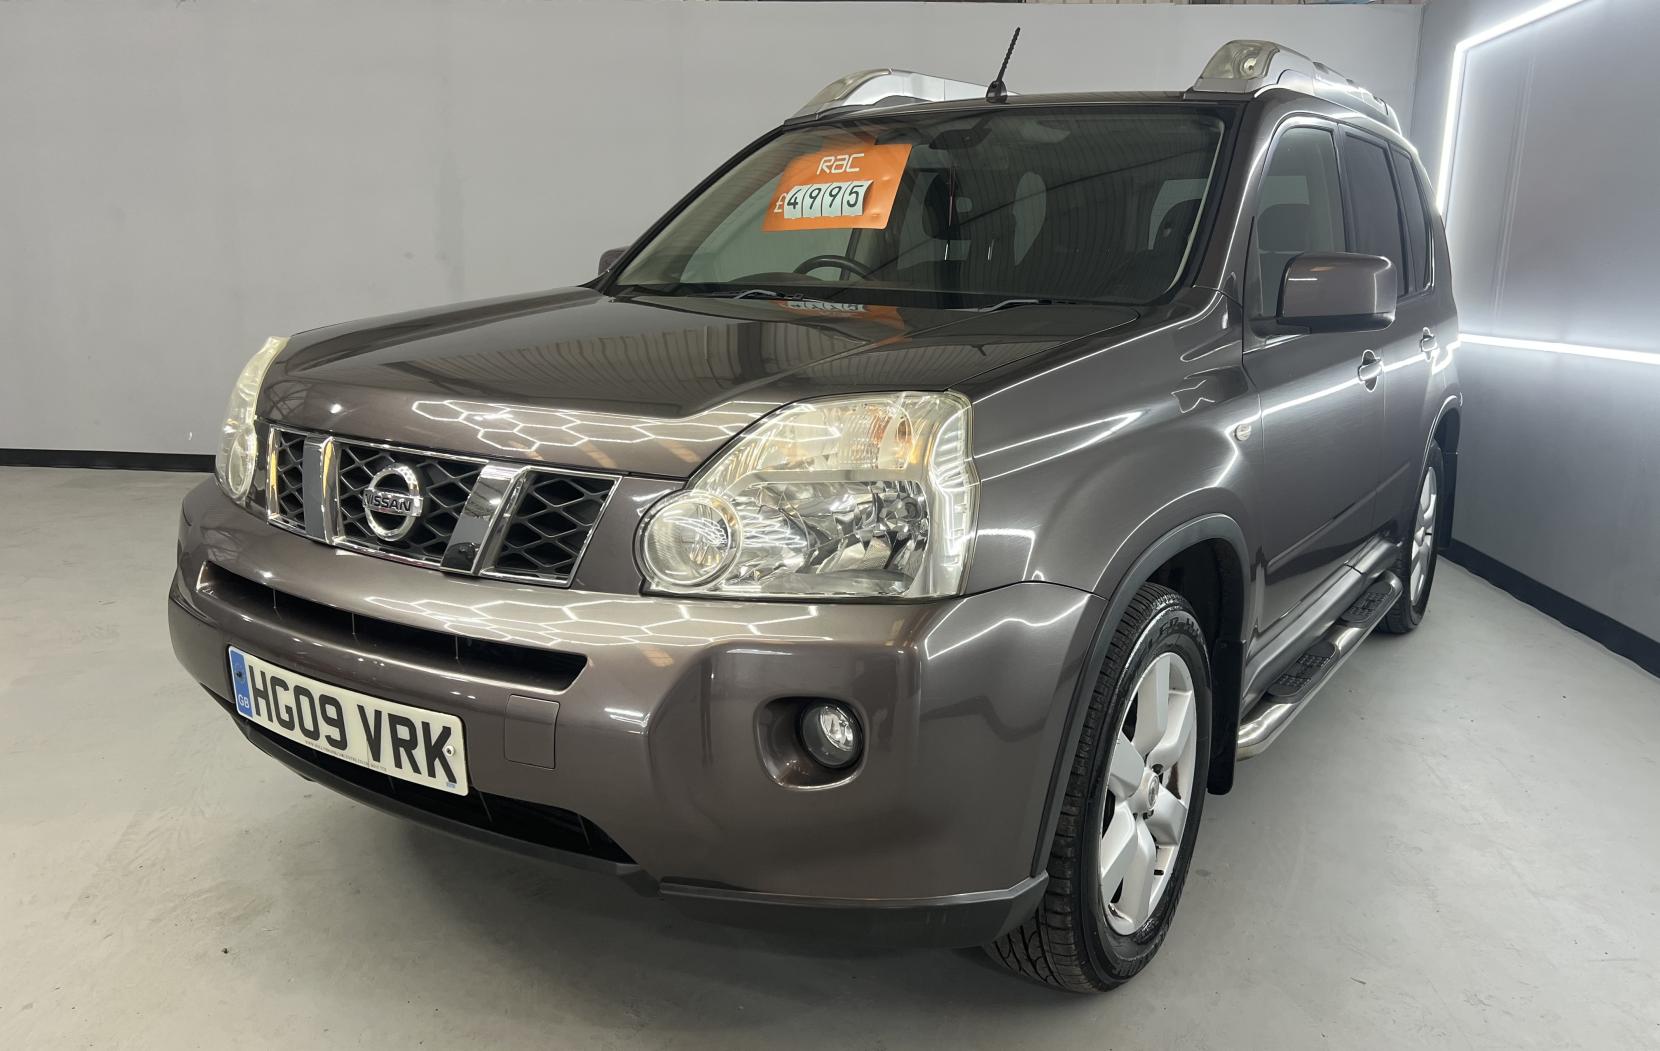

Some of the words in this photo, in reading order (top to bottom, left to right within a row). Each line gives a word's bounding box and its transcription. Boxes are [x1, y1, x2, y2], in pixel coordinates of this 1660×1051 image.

[364, 493, 413, 512] NISSAN
[238, 694, 250, 708] GB
[249, 665, 348, 751] HG09
[357, 704, 457, 784] VRK
